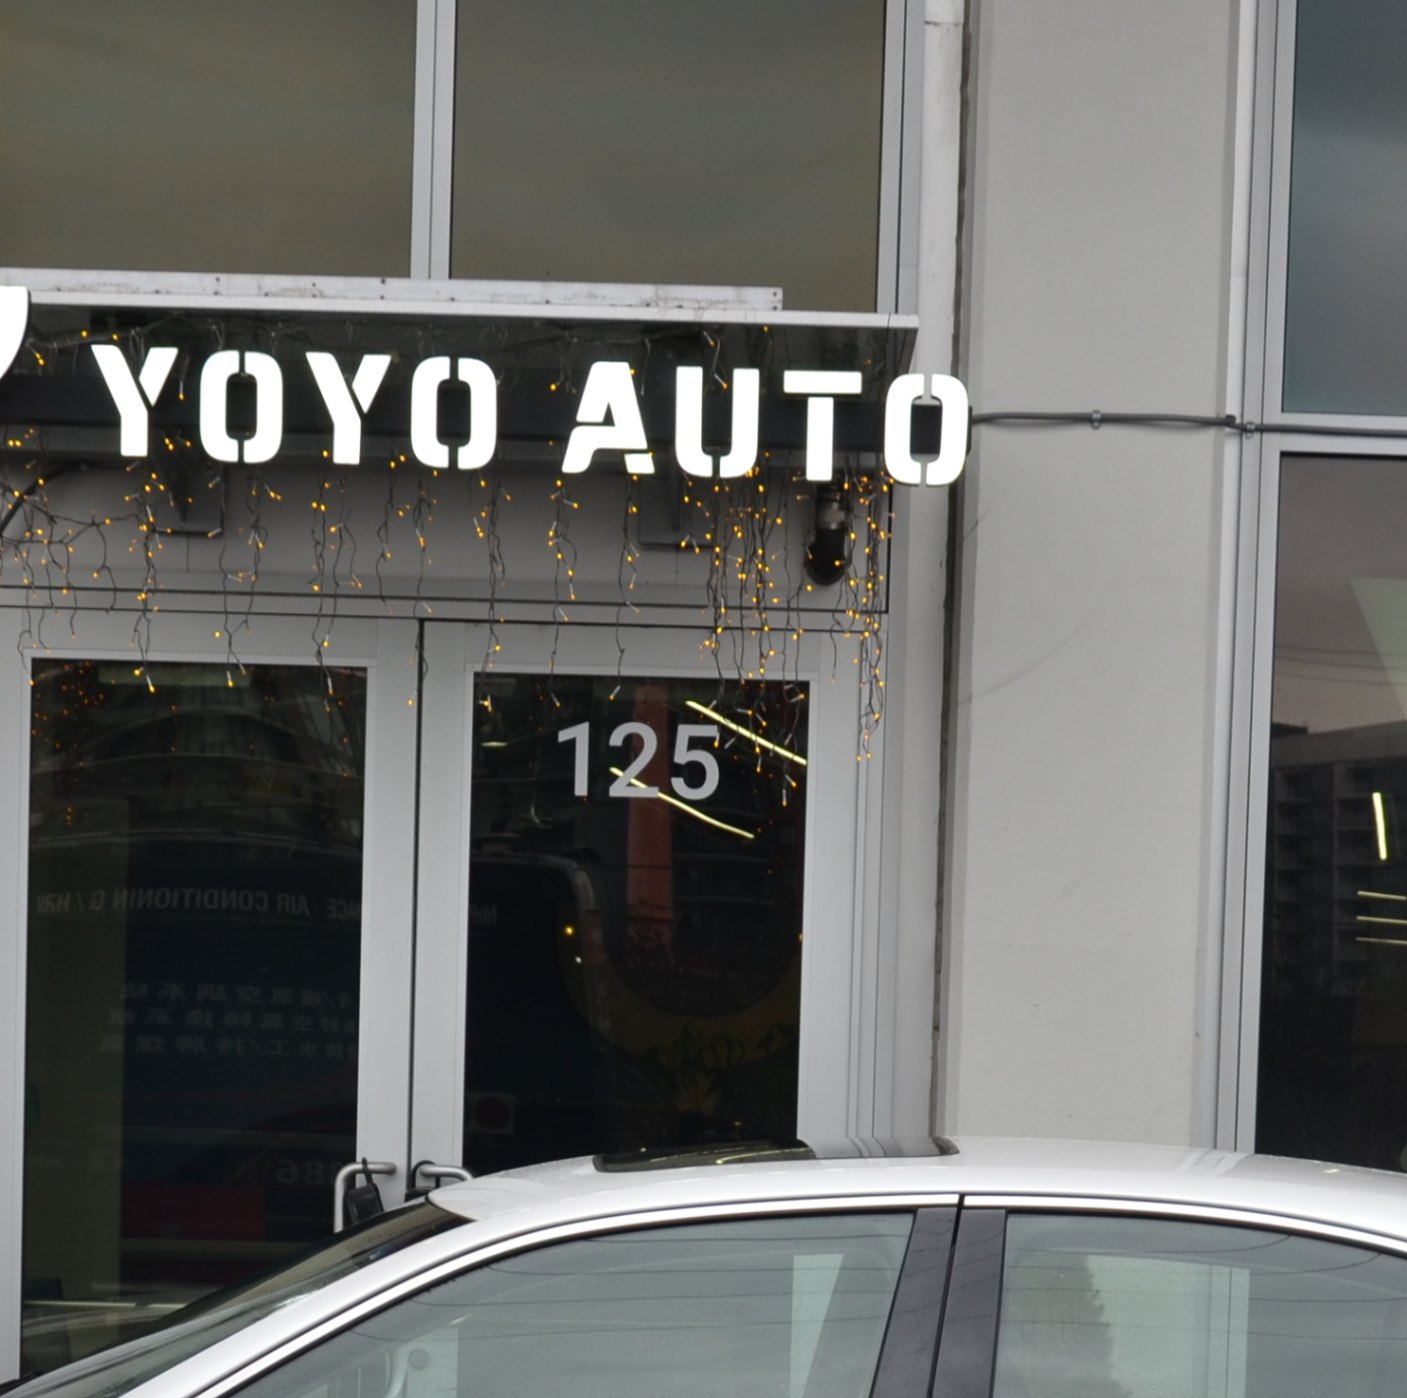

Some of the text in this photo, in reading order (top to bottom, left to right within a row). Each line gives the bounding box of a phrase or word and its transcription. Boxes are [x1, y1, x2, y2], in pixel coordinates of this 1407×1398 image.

[92, 345, 969, 486] YOYO AUTO
[557, 721, 721, 803] 125
